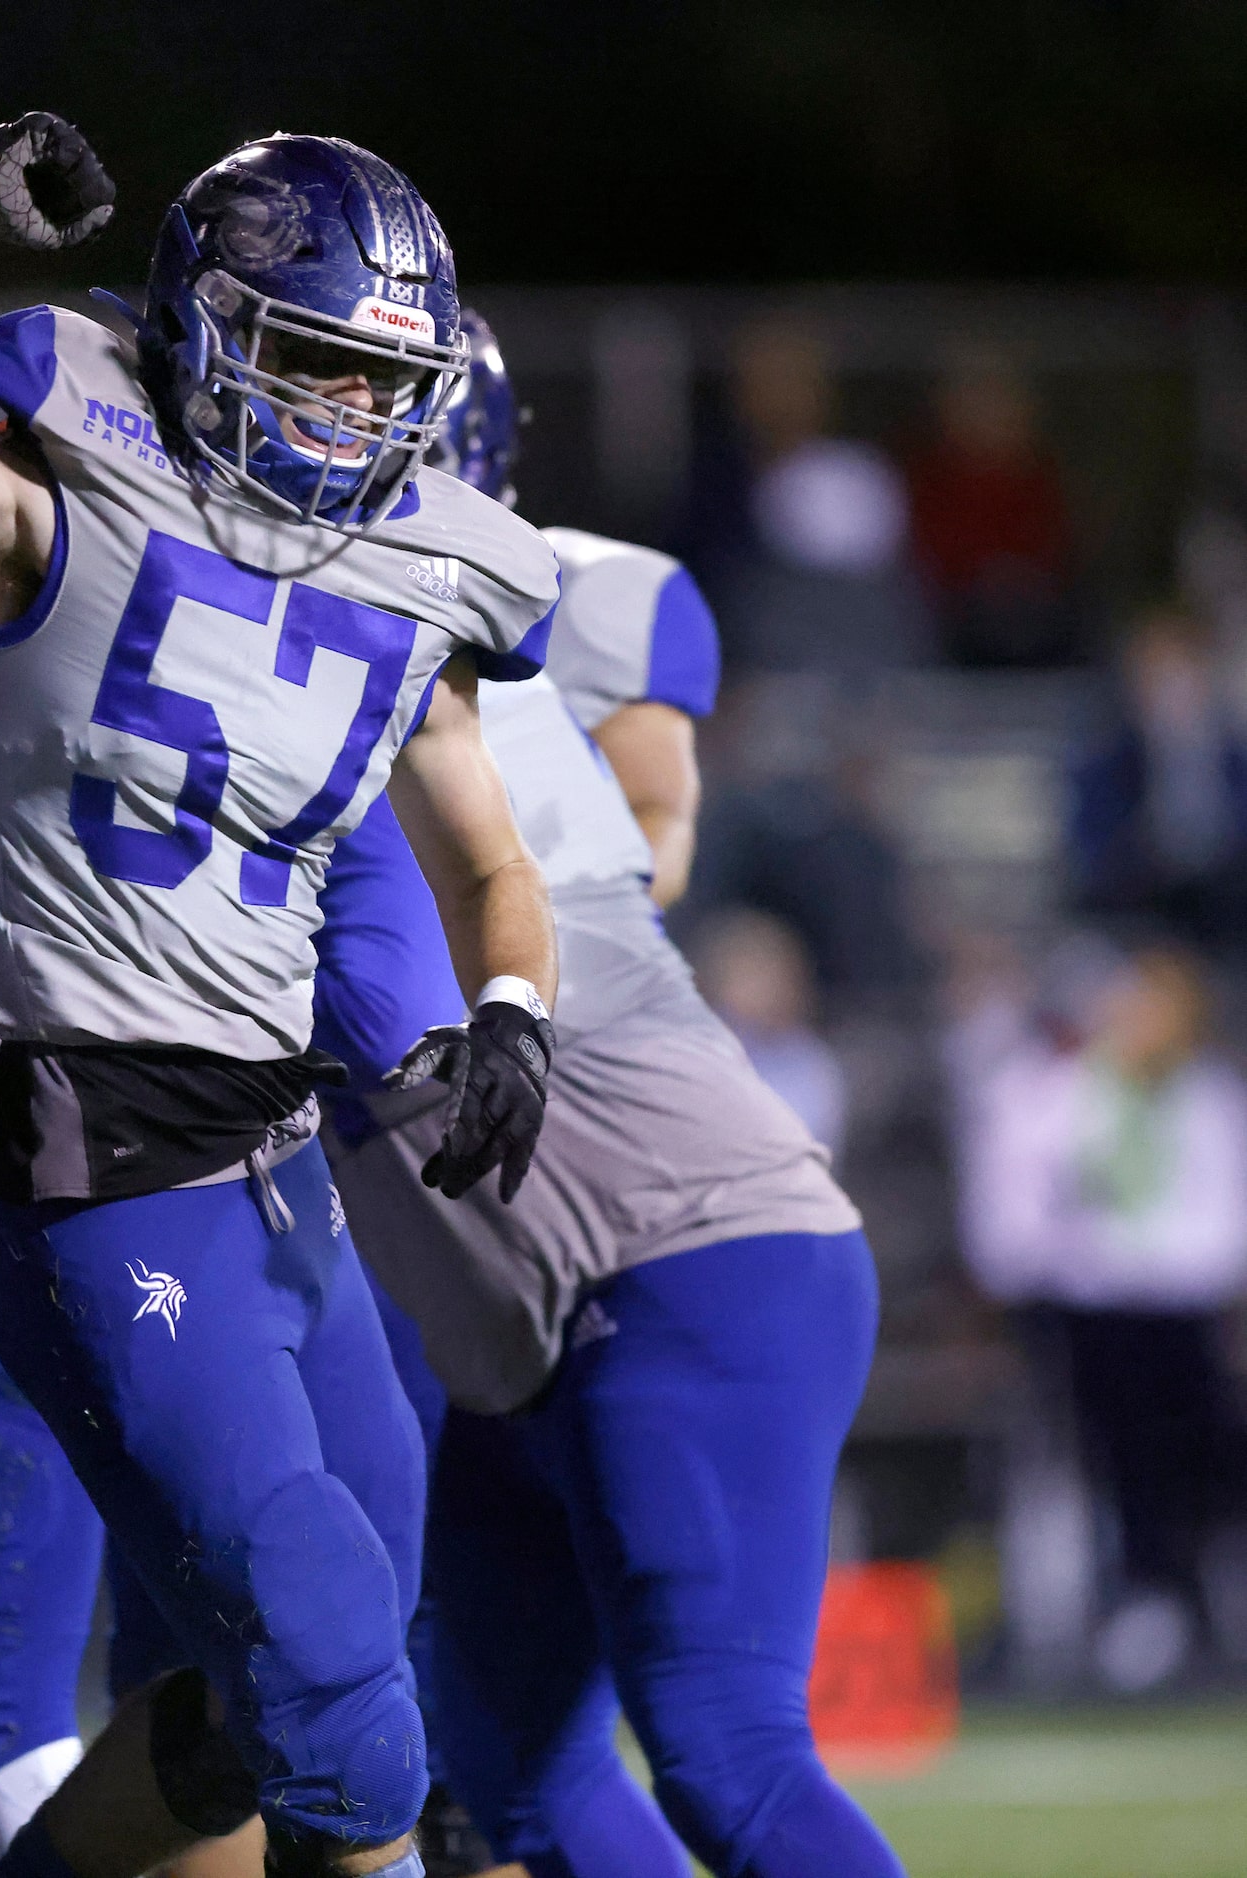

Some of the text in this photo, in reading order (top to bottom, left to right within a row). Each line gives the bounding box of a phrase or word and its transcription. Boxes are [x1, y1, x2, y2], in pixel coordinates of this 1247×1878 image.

[83, 419, 166, 470] CATHO
[85, 398, 168, 457] NOL
[405, 564, 458, 602] adidas
[69, 528, 418, 907] 57
